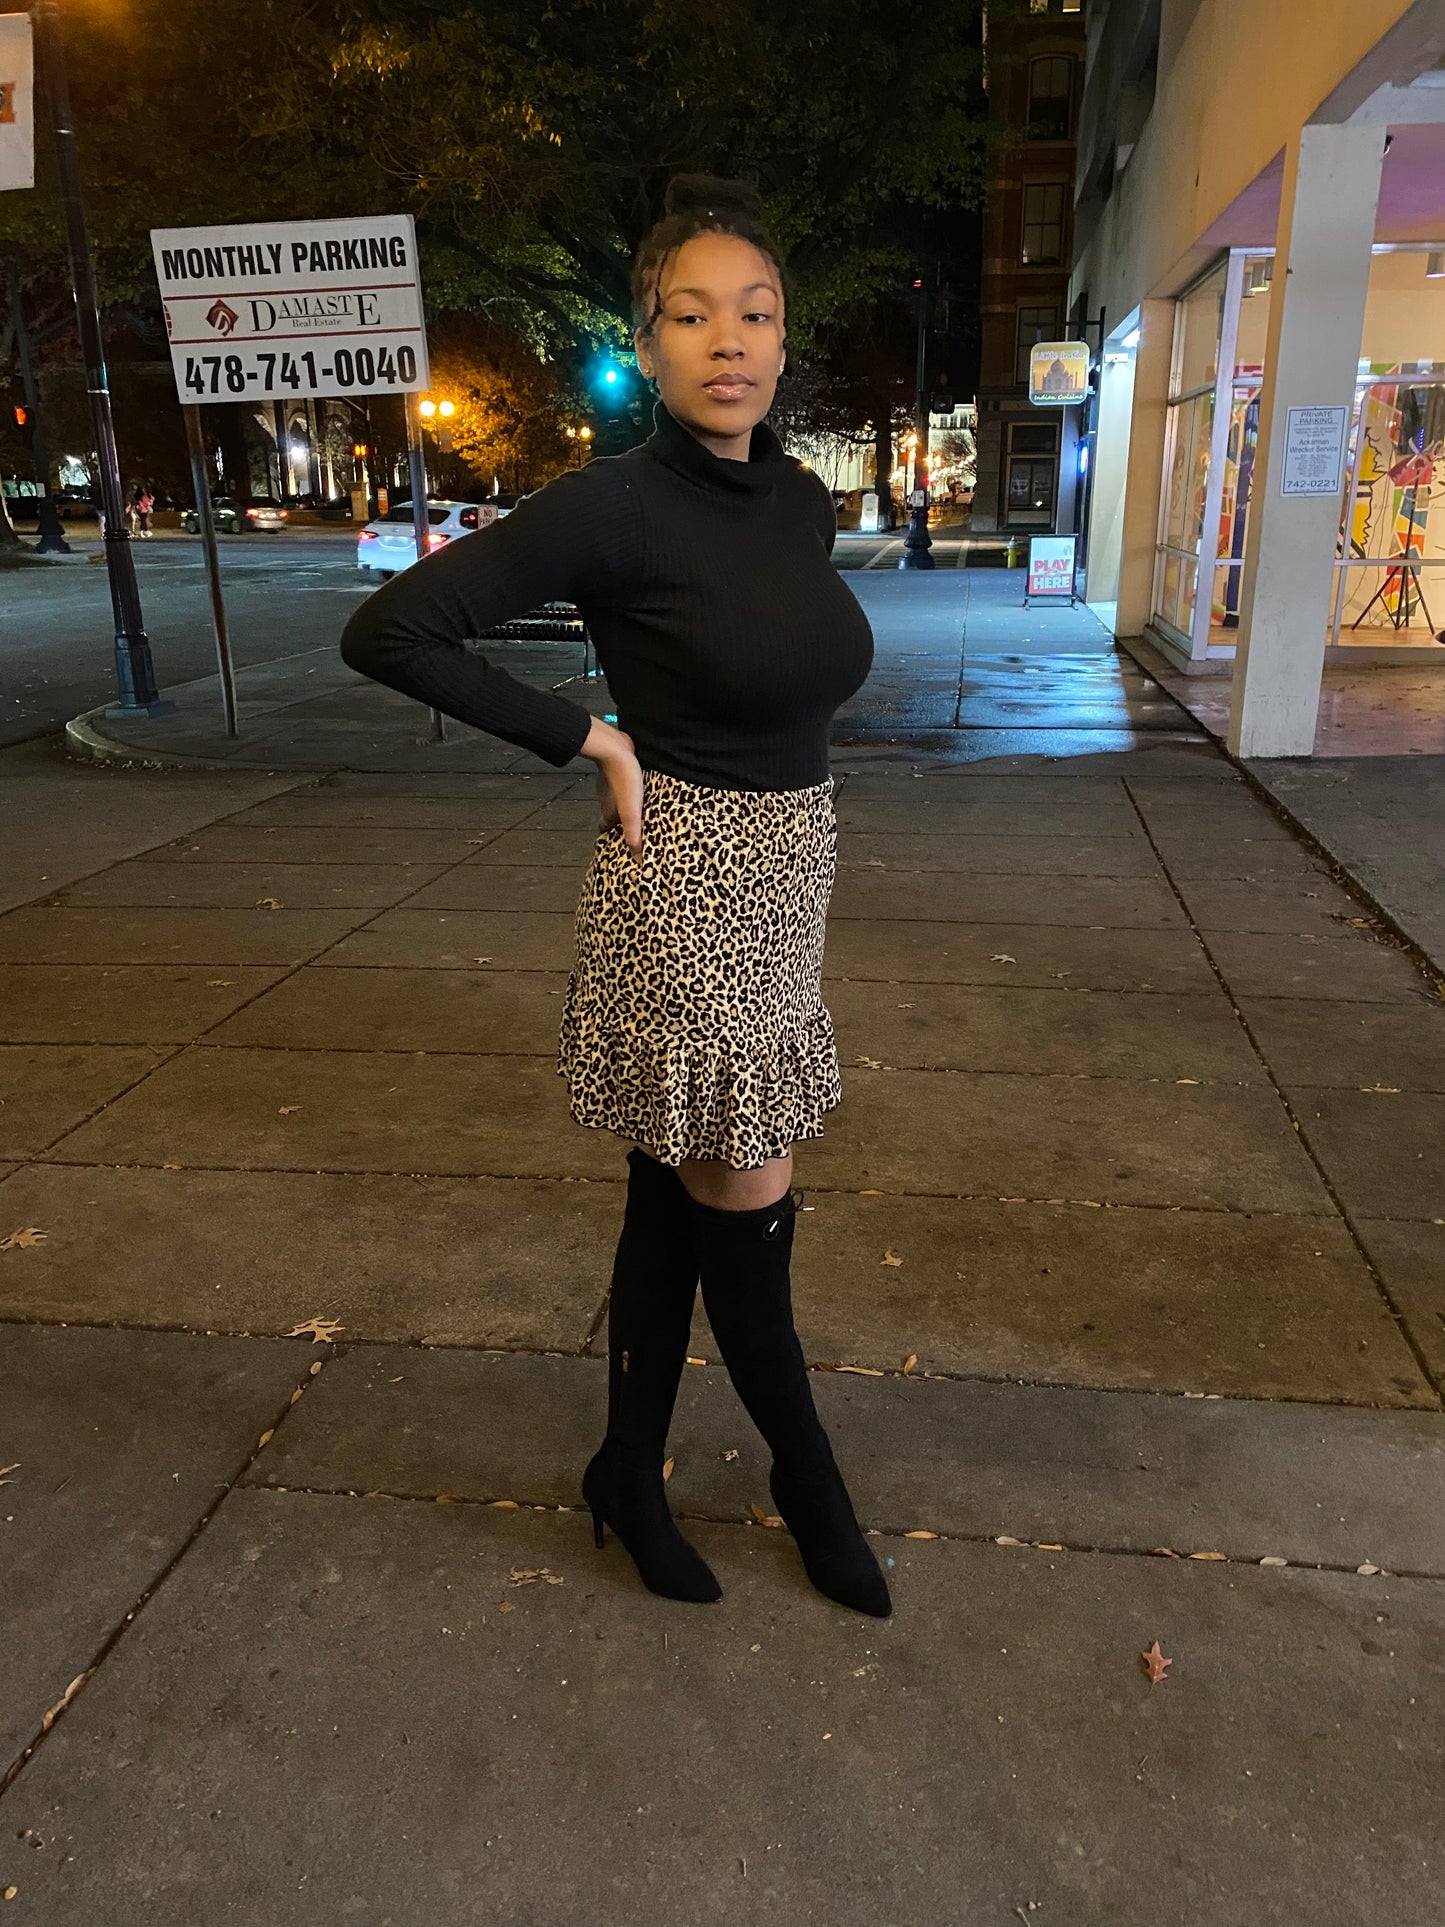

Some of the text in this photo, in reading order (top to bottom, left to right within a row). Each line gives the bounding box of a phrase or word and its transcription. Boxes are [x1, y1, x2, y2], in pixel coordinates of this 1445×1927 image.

[162, 236, 407, 280] MONTHLY PARKING
[247, 293, 381, 332] DAMASTE
[292, 317, 342, 328] Real Estate
[1061, 350, 1084, 360] India
[185, 345, 416, 394] 478-741-0040
[1287, 480, 1336, 488] 742-0221
[484, 510, 492, 518] NO
[1034, 559, 1071, 572] PLAY
[1033, 576, 1070, 590] HERE
